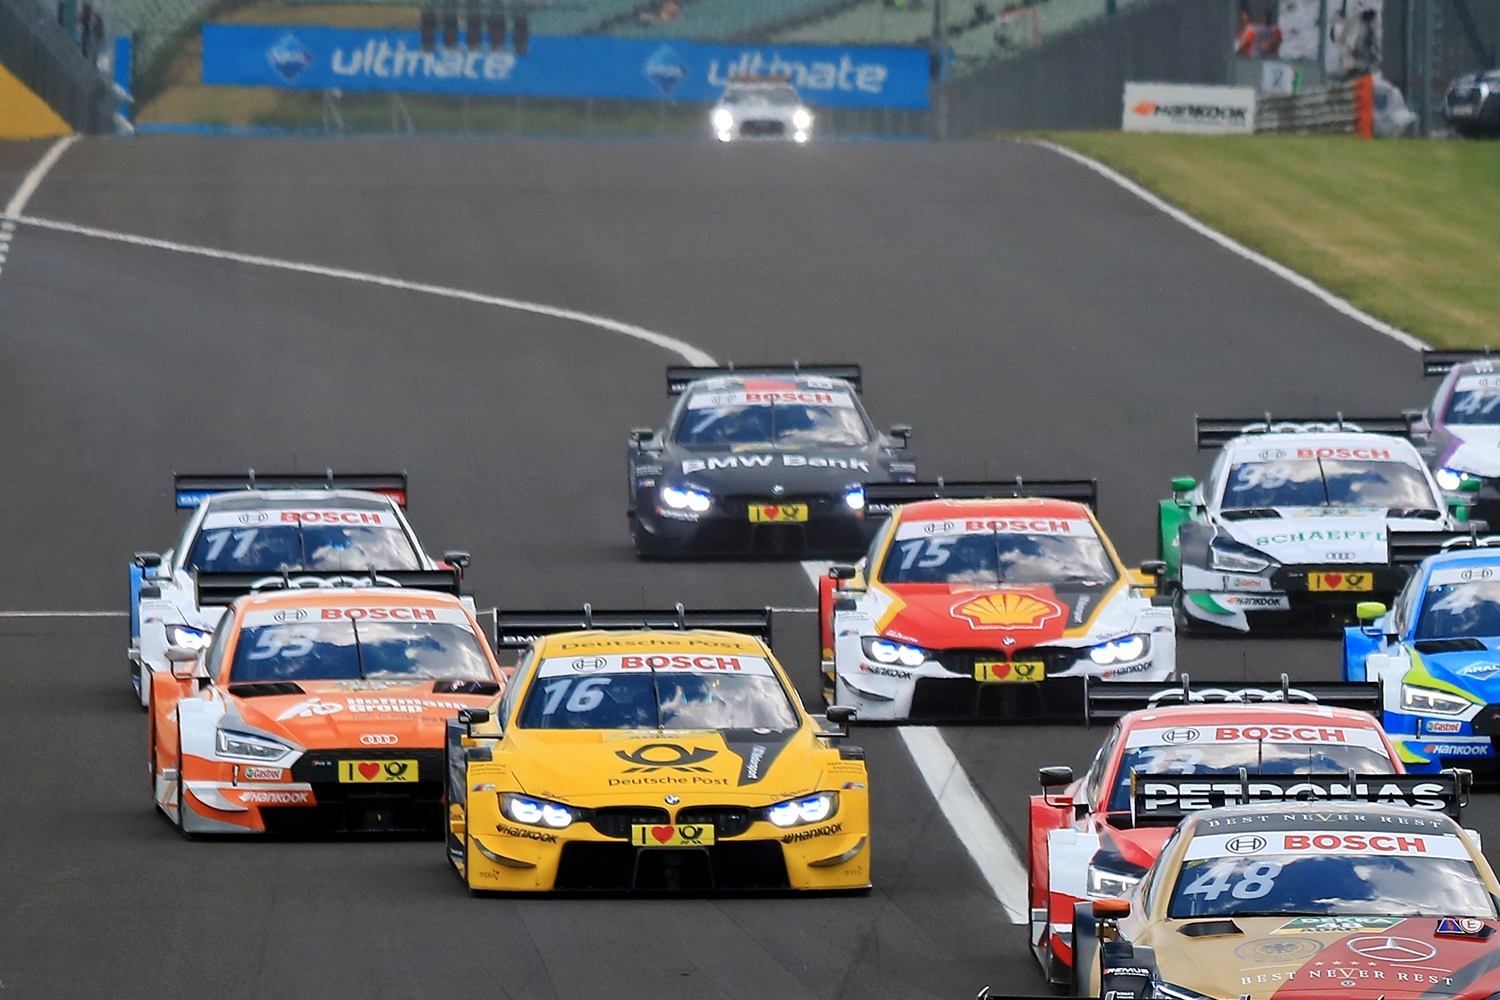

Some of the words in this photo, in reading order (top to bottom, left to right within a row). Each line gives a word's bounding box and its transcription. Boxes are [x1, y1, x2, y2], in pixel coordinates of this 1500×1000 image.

[746, 392, 833, 404] BOSCH
[1297, 449, 1391, 461] BOSCH
[681, 455, 774, 475] BMW
[783, 455, 870, 473] Bank
[1231, 465, 1293, 492] 99
[280, 511, 383, 525] BOSCH
[965, 519, 1071, 533] BOSCH
[205, 530, 258, 561] 11
[1256, 530, 1388, 546] SCHAEFFL
[900, 537, 959, 571] 15
[320, 607, 437, 621] BOSCH
[248, 626, 319, 661] 53
[561, 639, 682, 651] Deutsche
[688, 640, 744, 650] Post
[621, 655, 742, 671] BOSCH
[345, 697, 468, 711] Hoffmann
[543, 677, 611, 716] 16
[347, 704, 423, 714] Group
[1215, 727, 1346, 743] BOSCH
[608, 776, 689, 787] Deutsche
[692, 775, 730, 787] Post
[1143, 783, 1446, 811] PETRONAS
[1209, 814, 1269, 828] BEST
[1283, 812, 1368, 824] NEVER
[1381, 815, 1444, 829] REST
[1283, 834, 1427, 853] BOSCH
[1183, 862, 1284, 901] 48
[1300, 917, 1394, 925] DEKRA
[1240, 971, 1297, 986] BEST
[1309, 968, 1386, 980] NEVER
[1398, 972, 1455, 987] REST
